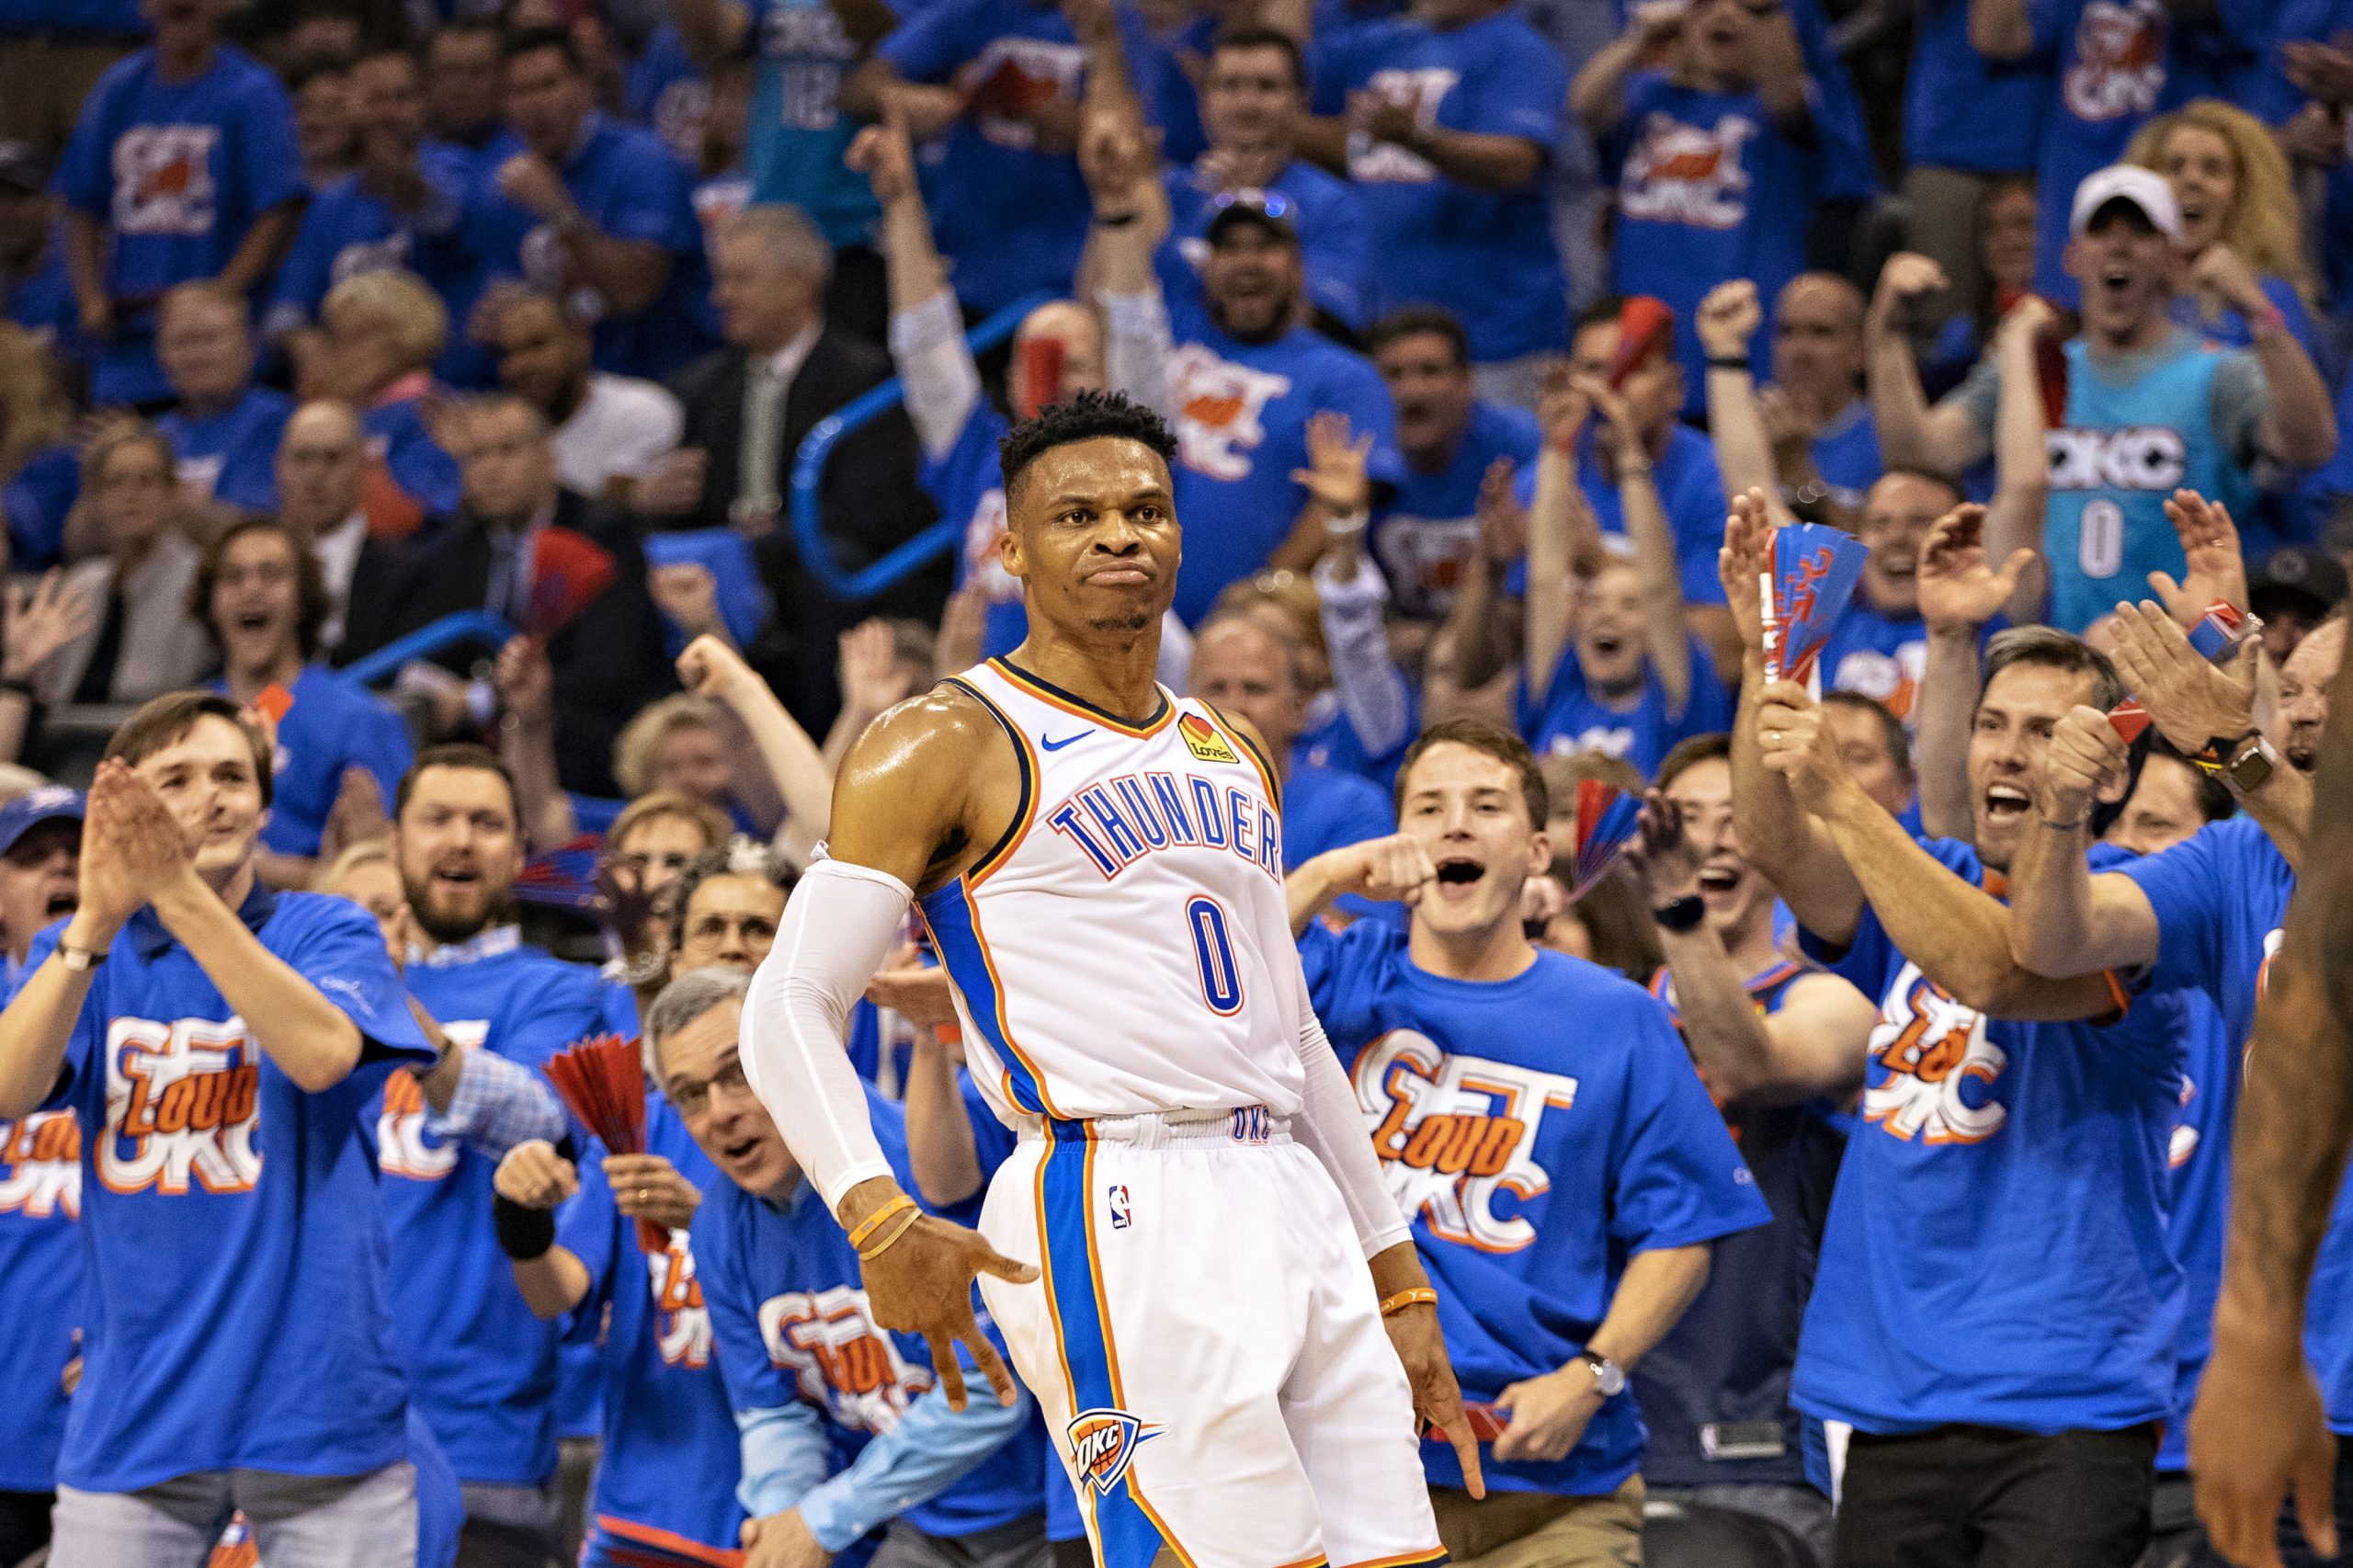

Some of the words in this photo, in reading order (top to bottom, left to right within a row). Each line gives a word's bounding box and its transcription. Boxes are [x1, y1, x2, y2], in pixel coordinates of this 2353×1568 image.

[2079, 499, 2124, 579] 0
[1046, 772, 1280, 886] THUNDER
[1185, 894, 1245, 1018] 0
[123, 1061, 259, 1138] LOUD
[1349, 1027, 1579, 1144] GET
[1370, 1101, 1526, 1178] LOUD
[1374, 1156, 1551, 1255] KC
[1076, 1424, 1120, 1481] OKC
